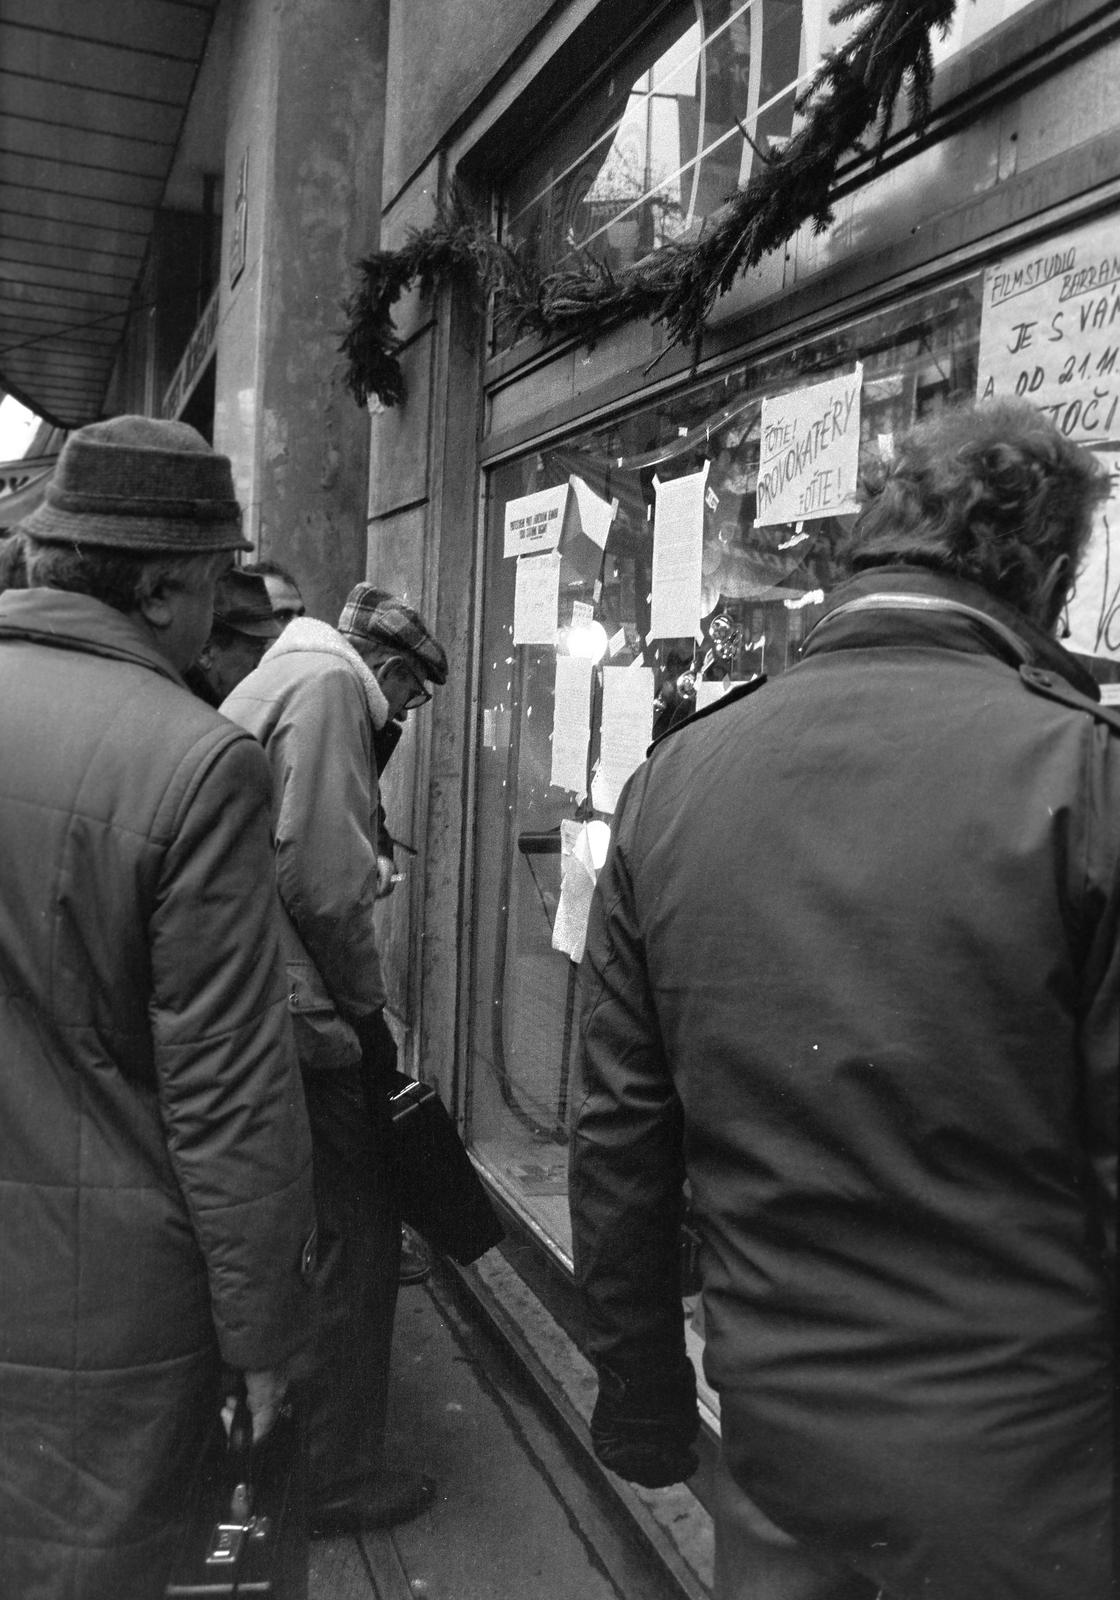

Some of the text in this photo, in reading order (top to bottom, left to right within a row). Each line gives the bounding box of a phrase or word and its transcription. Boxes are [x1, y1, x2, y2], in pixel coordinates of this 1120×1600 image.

[991, 246, 1076, 302] FILMSTUDIO
[1006, 321, 1039, 354] JE
[1048, 311, 1064, 342] S
[981, 375, 995, 401] A
[1015, 365, 1045, 398] OD
